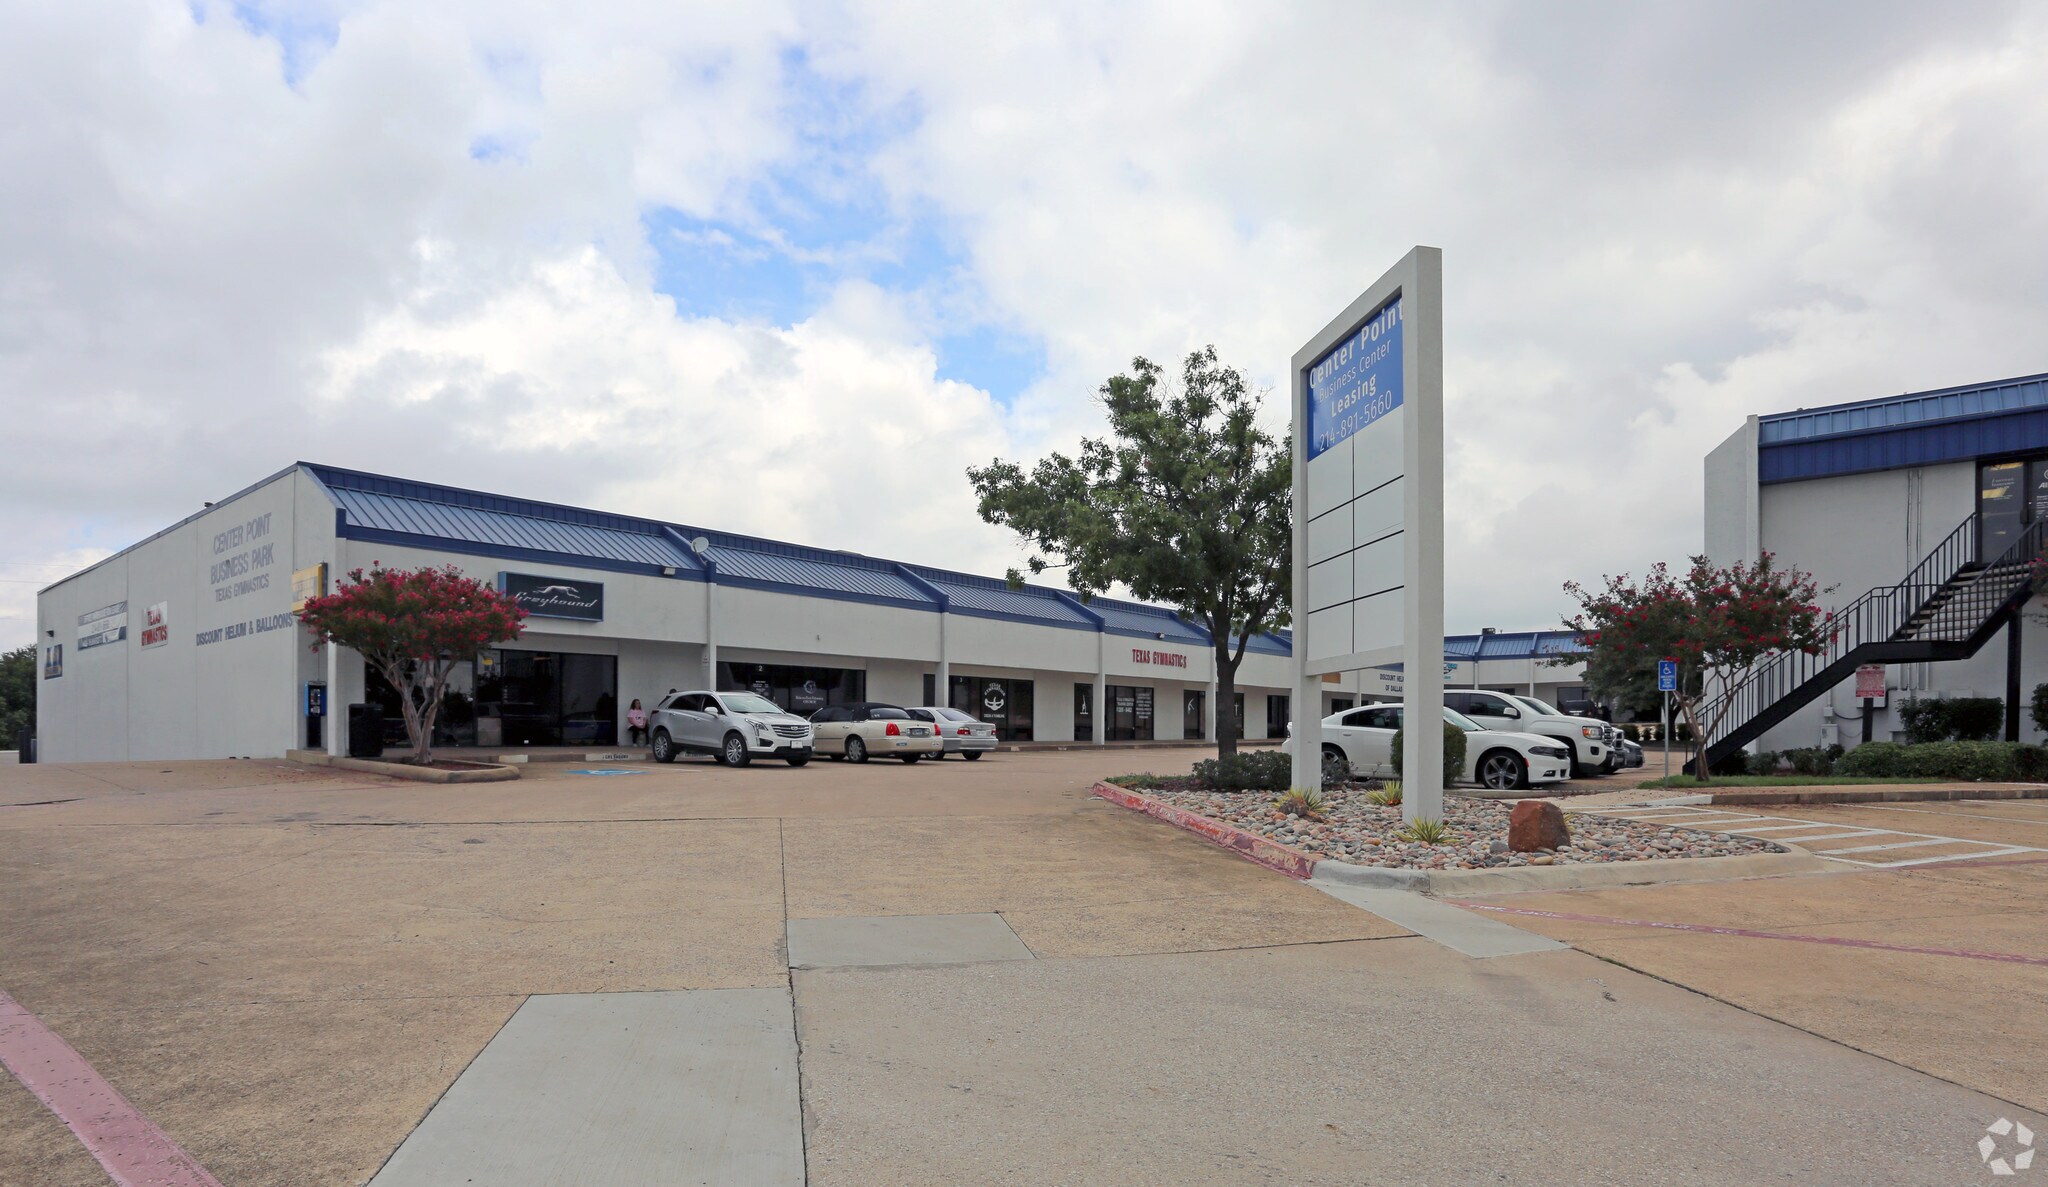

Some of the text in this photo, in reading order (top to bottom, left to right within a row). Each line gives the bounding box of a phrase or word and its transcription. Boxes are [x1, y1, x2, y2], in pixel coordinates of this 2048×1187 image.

[1310, 299, 1403, 389] Center Point
[1319, 339, 1392, 403] Business Center
[1331, 373, 1377, 418] Leasing
[1319, 389, 1392, 452] 214-891-5660
[213, 512, 272, 555] CENTER POINT
[211, 542, 275, 585] BUSINESS PARK
[215, 573, 270, 602] TEXAS GYMNASTICS
[514, 591, 598, 608] Greyhound
[141, 624, 168, 646] GYMNASTICS
[147, 609, 161, 627] TEXAS
[196, 612, 293, 647] DISCOUNT HELIUM & BALLOONS
[1132, 649, 1187, 669] TEXAS GYMNASTICS
[1379, 673, 1396, 681] DISCOUNT
